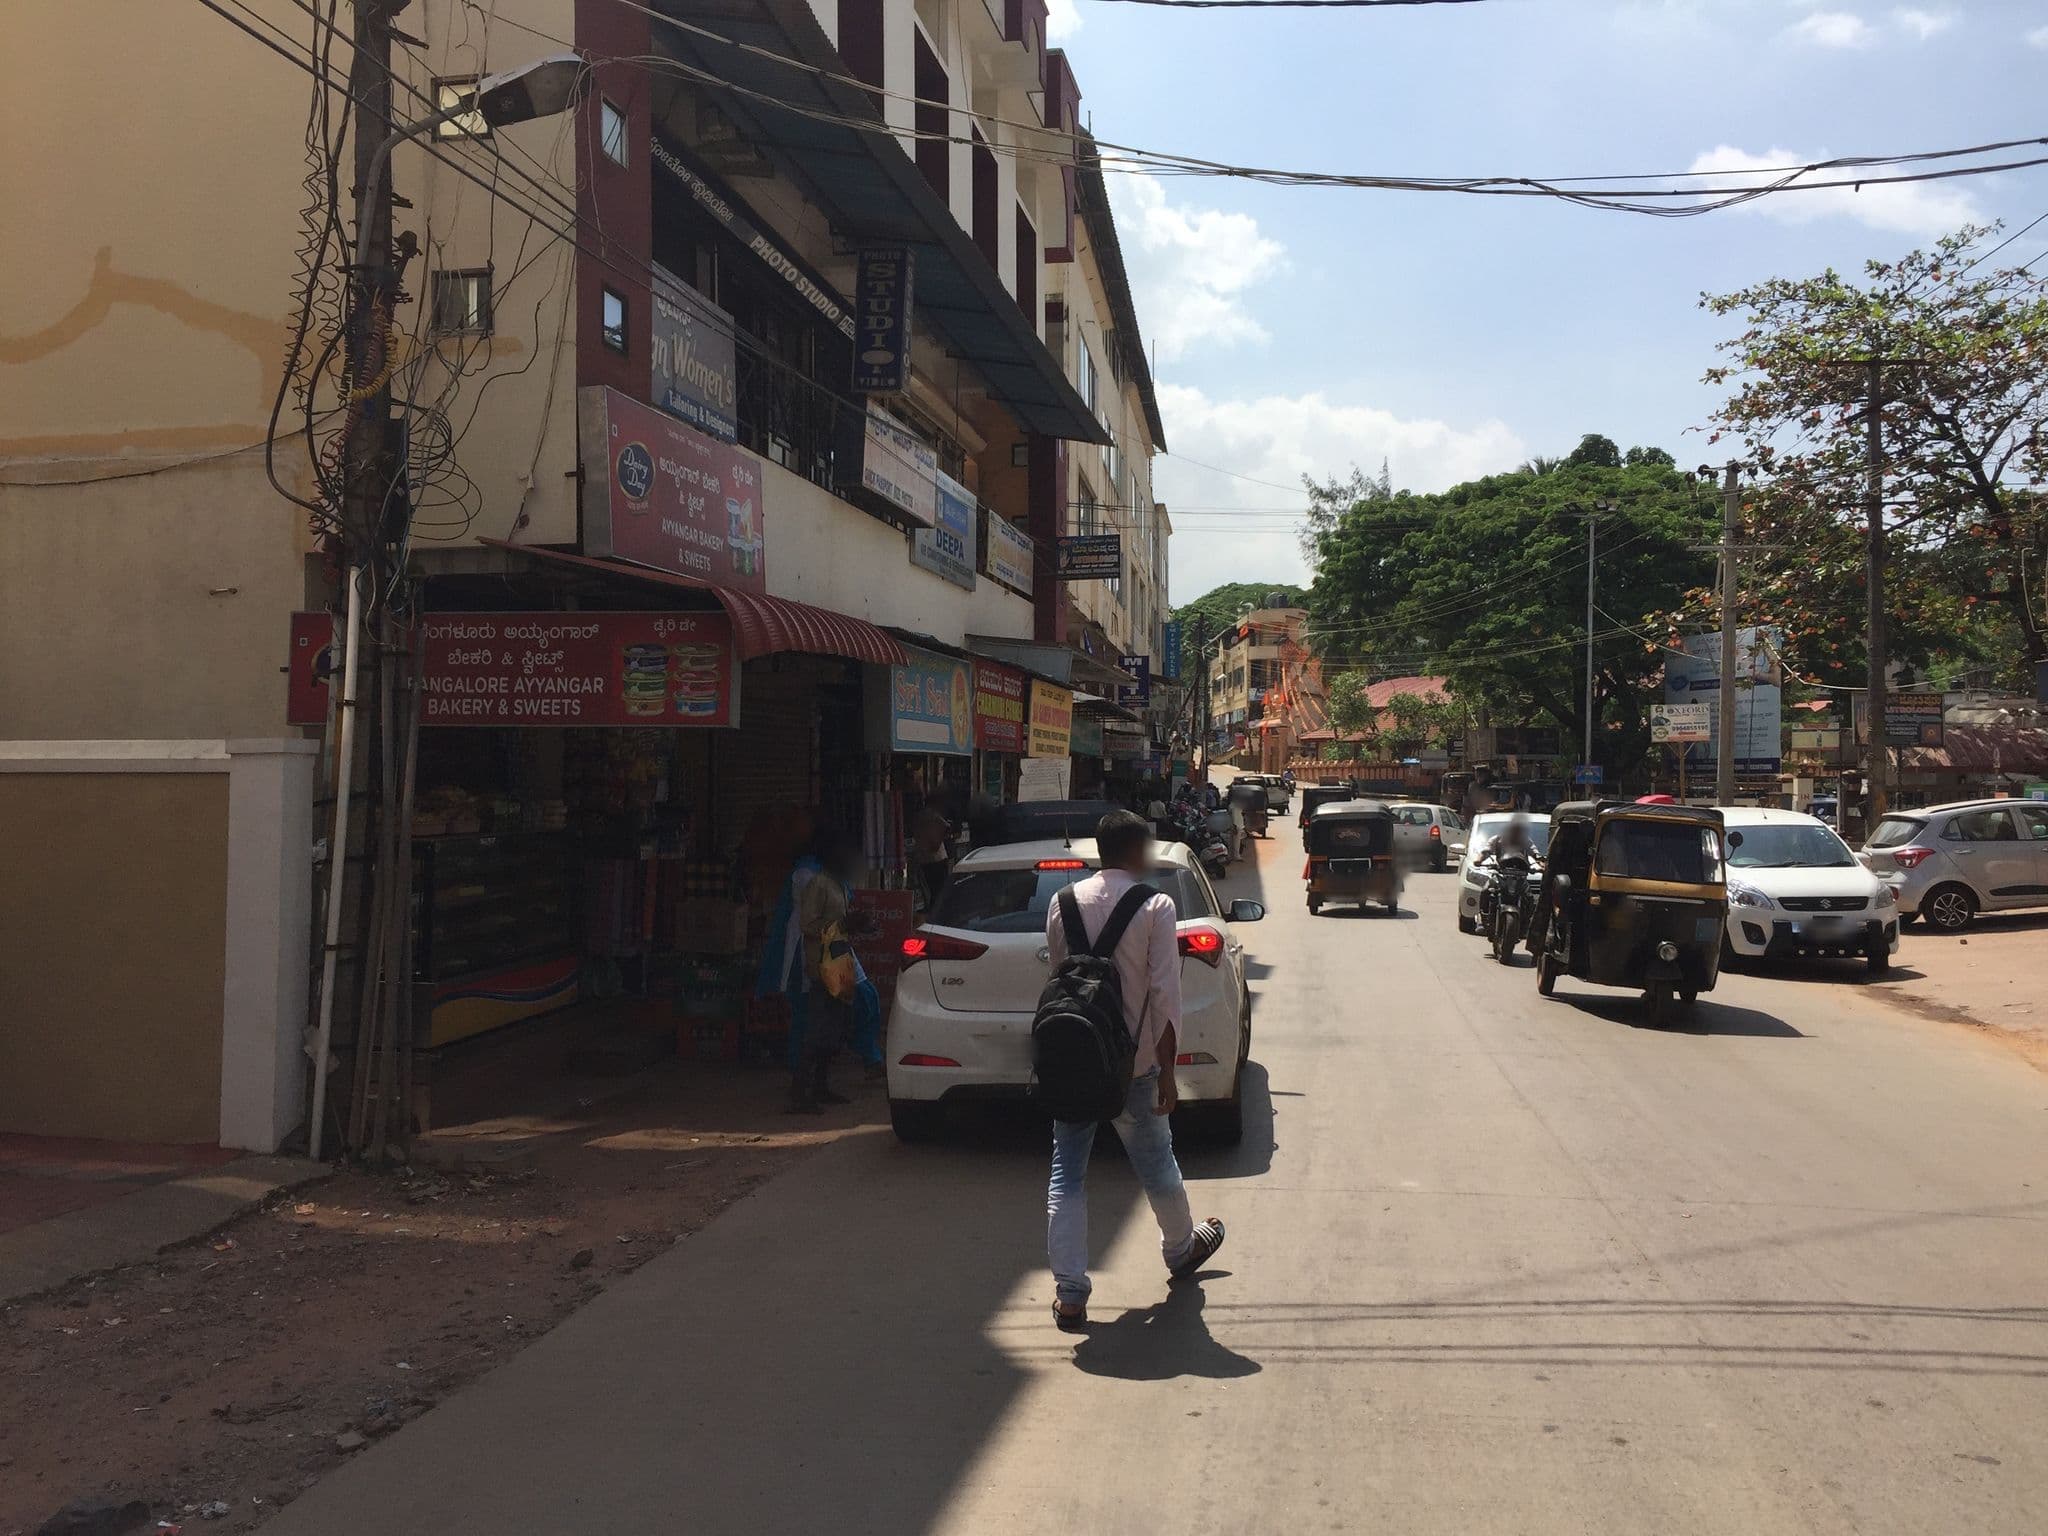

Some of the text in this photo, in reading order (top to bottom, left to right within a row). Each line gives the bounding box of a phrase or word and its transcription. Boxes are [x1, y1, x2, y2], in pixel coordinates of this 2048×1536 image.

[751, 235, 840, 320] PHOTO STUDIO
[862, 263, 898, 366] STUDIO
[672, 331, 732, 408] Women's
[668, 390, 697, 422] Tailoring
[698, 407, 704, 423] &
[623, 447, 648, 479] Dairy
[627, 467, 646, 497] Day
[661, 518, 725, 552] AYYANGAR BAKERY
[936, 528, 965, 561] DEEPA
[678, 548, 712, 572] & SWEETS
[504, 622, 600, 649] ಅಯ್ಯಂಗಾರ್
[653, 618, 677, 640] ಡೈರಿ
[447, 649, 492, 665] ಬೇಕರಿ
[501, 652, 514, 666] &
[513, 677, 604, 694] AYYANGAR
[895, 669, 922, 714] Sri
[926, 676, 951, 718] Sai
[427, 698, 581, 716] BAKERY & SWEETS
[1667, 704, 1709, 716] OXFORD
